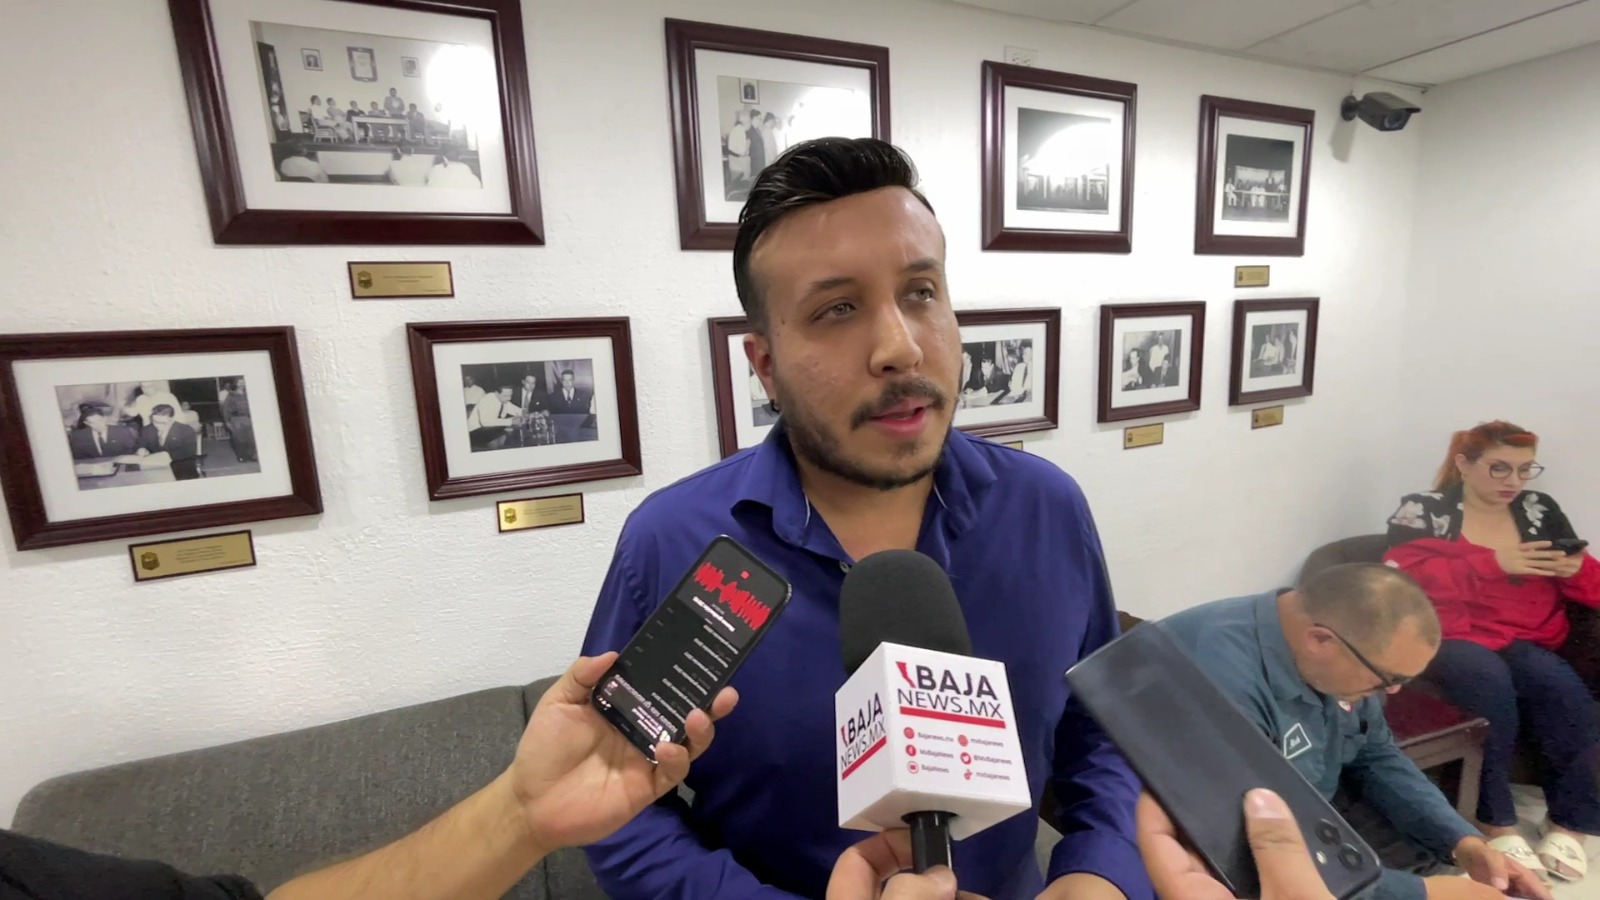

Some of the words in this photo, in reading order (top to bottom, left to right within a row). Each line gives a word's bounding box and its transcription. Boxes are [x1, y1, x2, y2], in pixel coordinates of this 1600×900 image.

[897, 688, 1003, 719] NEWS.MX
[916, 665, 998, 700] BAJA
[848, 692, 883, 745] BAJA
[841, 716, 886, 770] NEWS.MX
